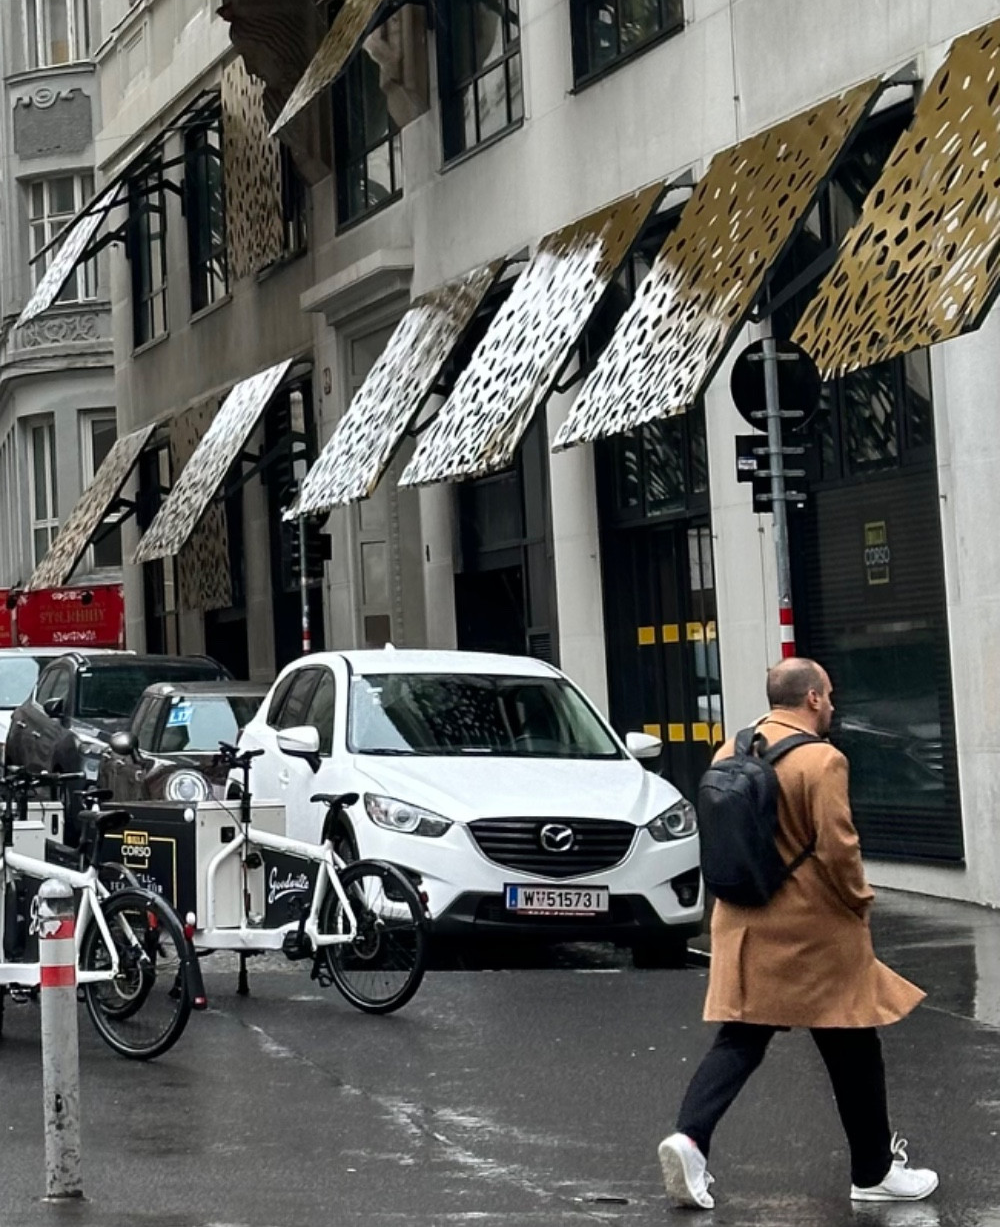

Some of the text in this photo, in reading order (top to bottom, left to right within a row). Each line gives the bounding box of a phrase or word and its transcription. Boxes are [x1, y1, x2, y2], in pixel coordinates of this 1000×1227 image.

[864, 546, 890, 565] CORSO
[120, 845, 152, 857] CORSO
[523, 891, 535, 907] W
[546, 891, 593, 908] 51573
